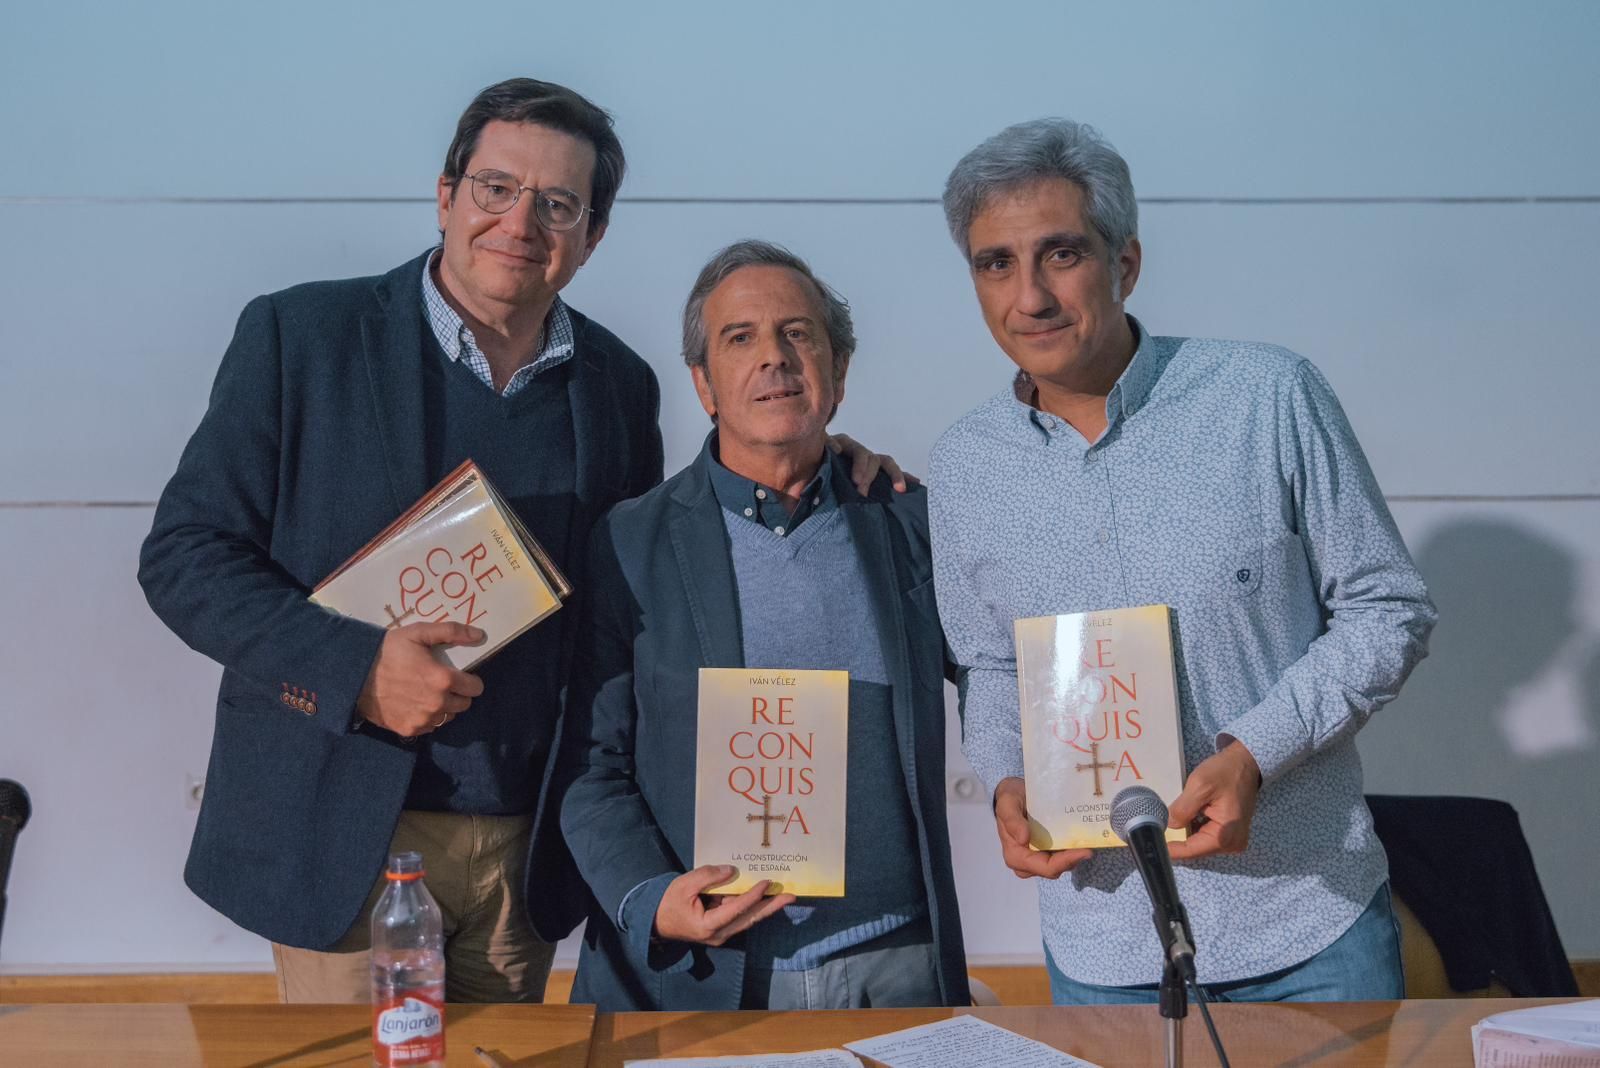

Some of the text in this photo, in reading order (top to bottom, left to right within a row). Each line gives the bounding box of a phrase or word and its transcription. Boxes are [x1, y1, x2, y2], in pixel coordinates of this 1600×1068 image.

[460, 542, 503, 592] RE
[398, 566, 450, 625] QUI
[425, 547, 488, 625] CON
[749, 677, 796, 686] IVÁN VÉLEZ
[751, 697, 795, 725] RE
[1053, 709, 1143, 753] QUIS
[729, 731, 815, 760] CON
[728, 766, 815, 805] QUIS
[1064, 803, 1110, 814] LA CONSTR
[1082, 814, 1110, 823] DE ESP
[731, 853, 808, 862] LA CONSTRUCCIÓN
[748, 864, 791, 872] DE ESPAÑA
